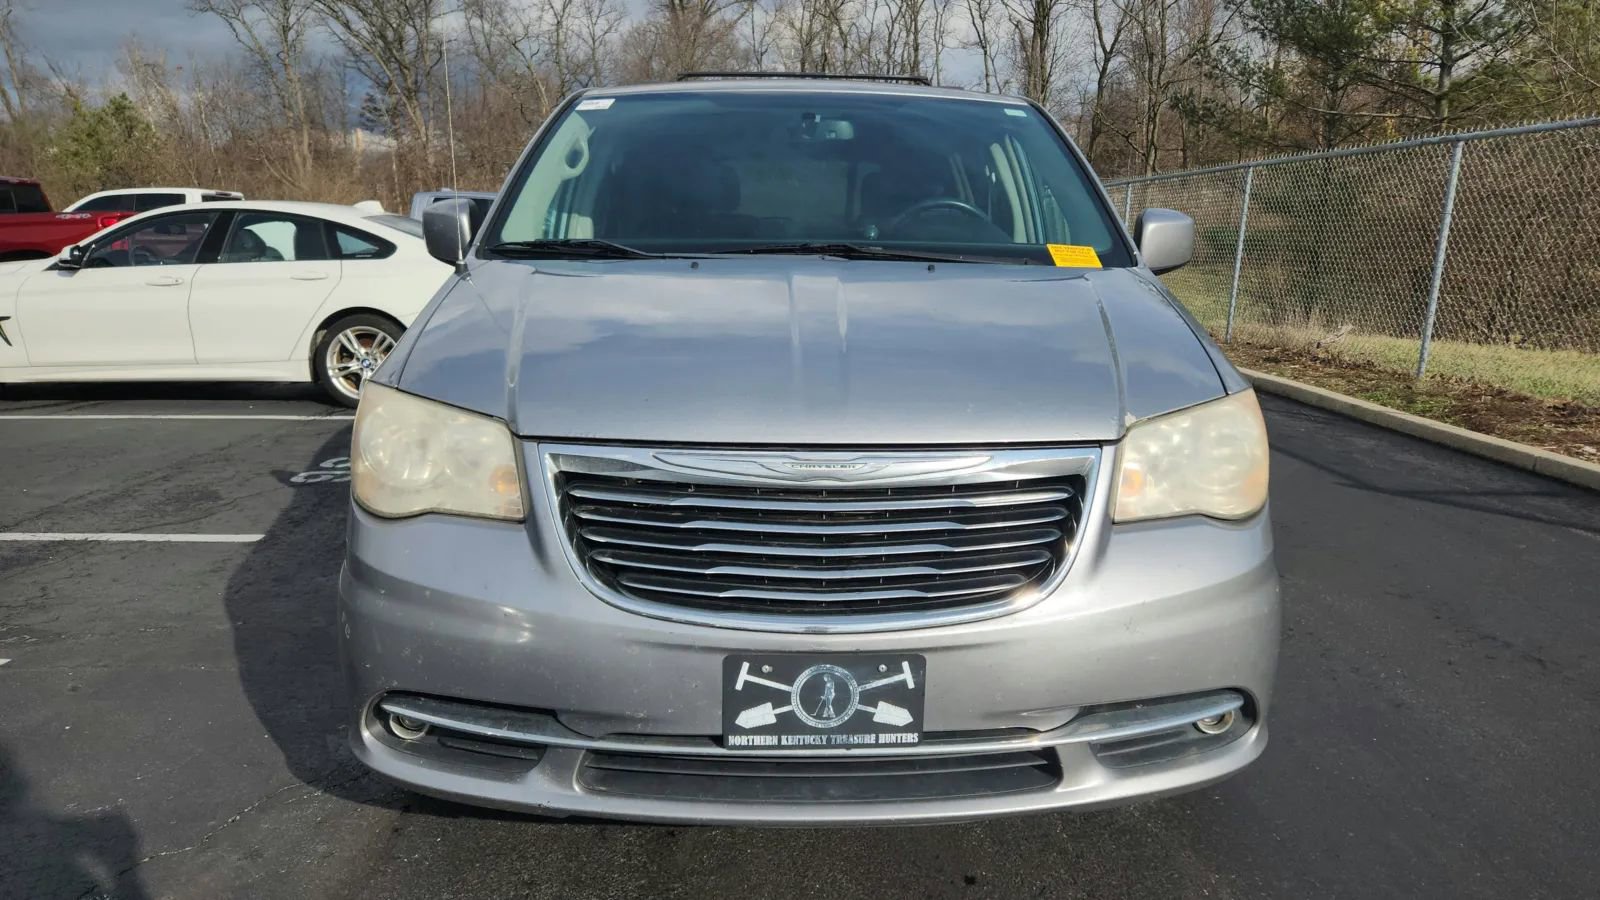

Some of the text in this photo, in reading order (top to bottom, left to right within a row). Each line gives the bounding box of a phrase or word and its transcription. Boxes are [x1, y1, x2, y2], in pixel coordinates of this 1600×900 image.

[728, 732, 919, 746] NORTHERN KENTUCKY TREASURE HUNTERS
